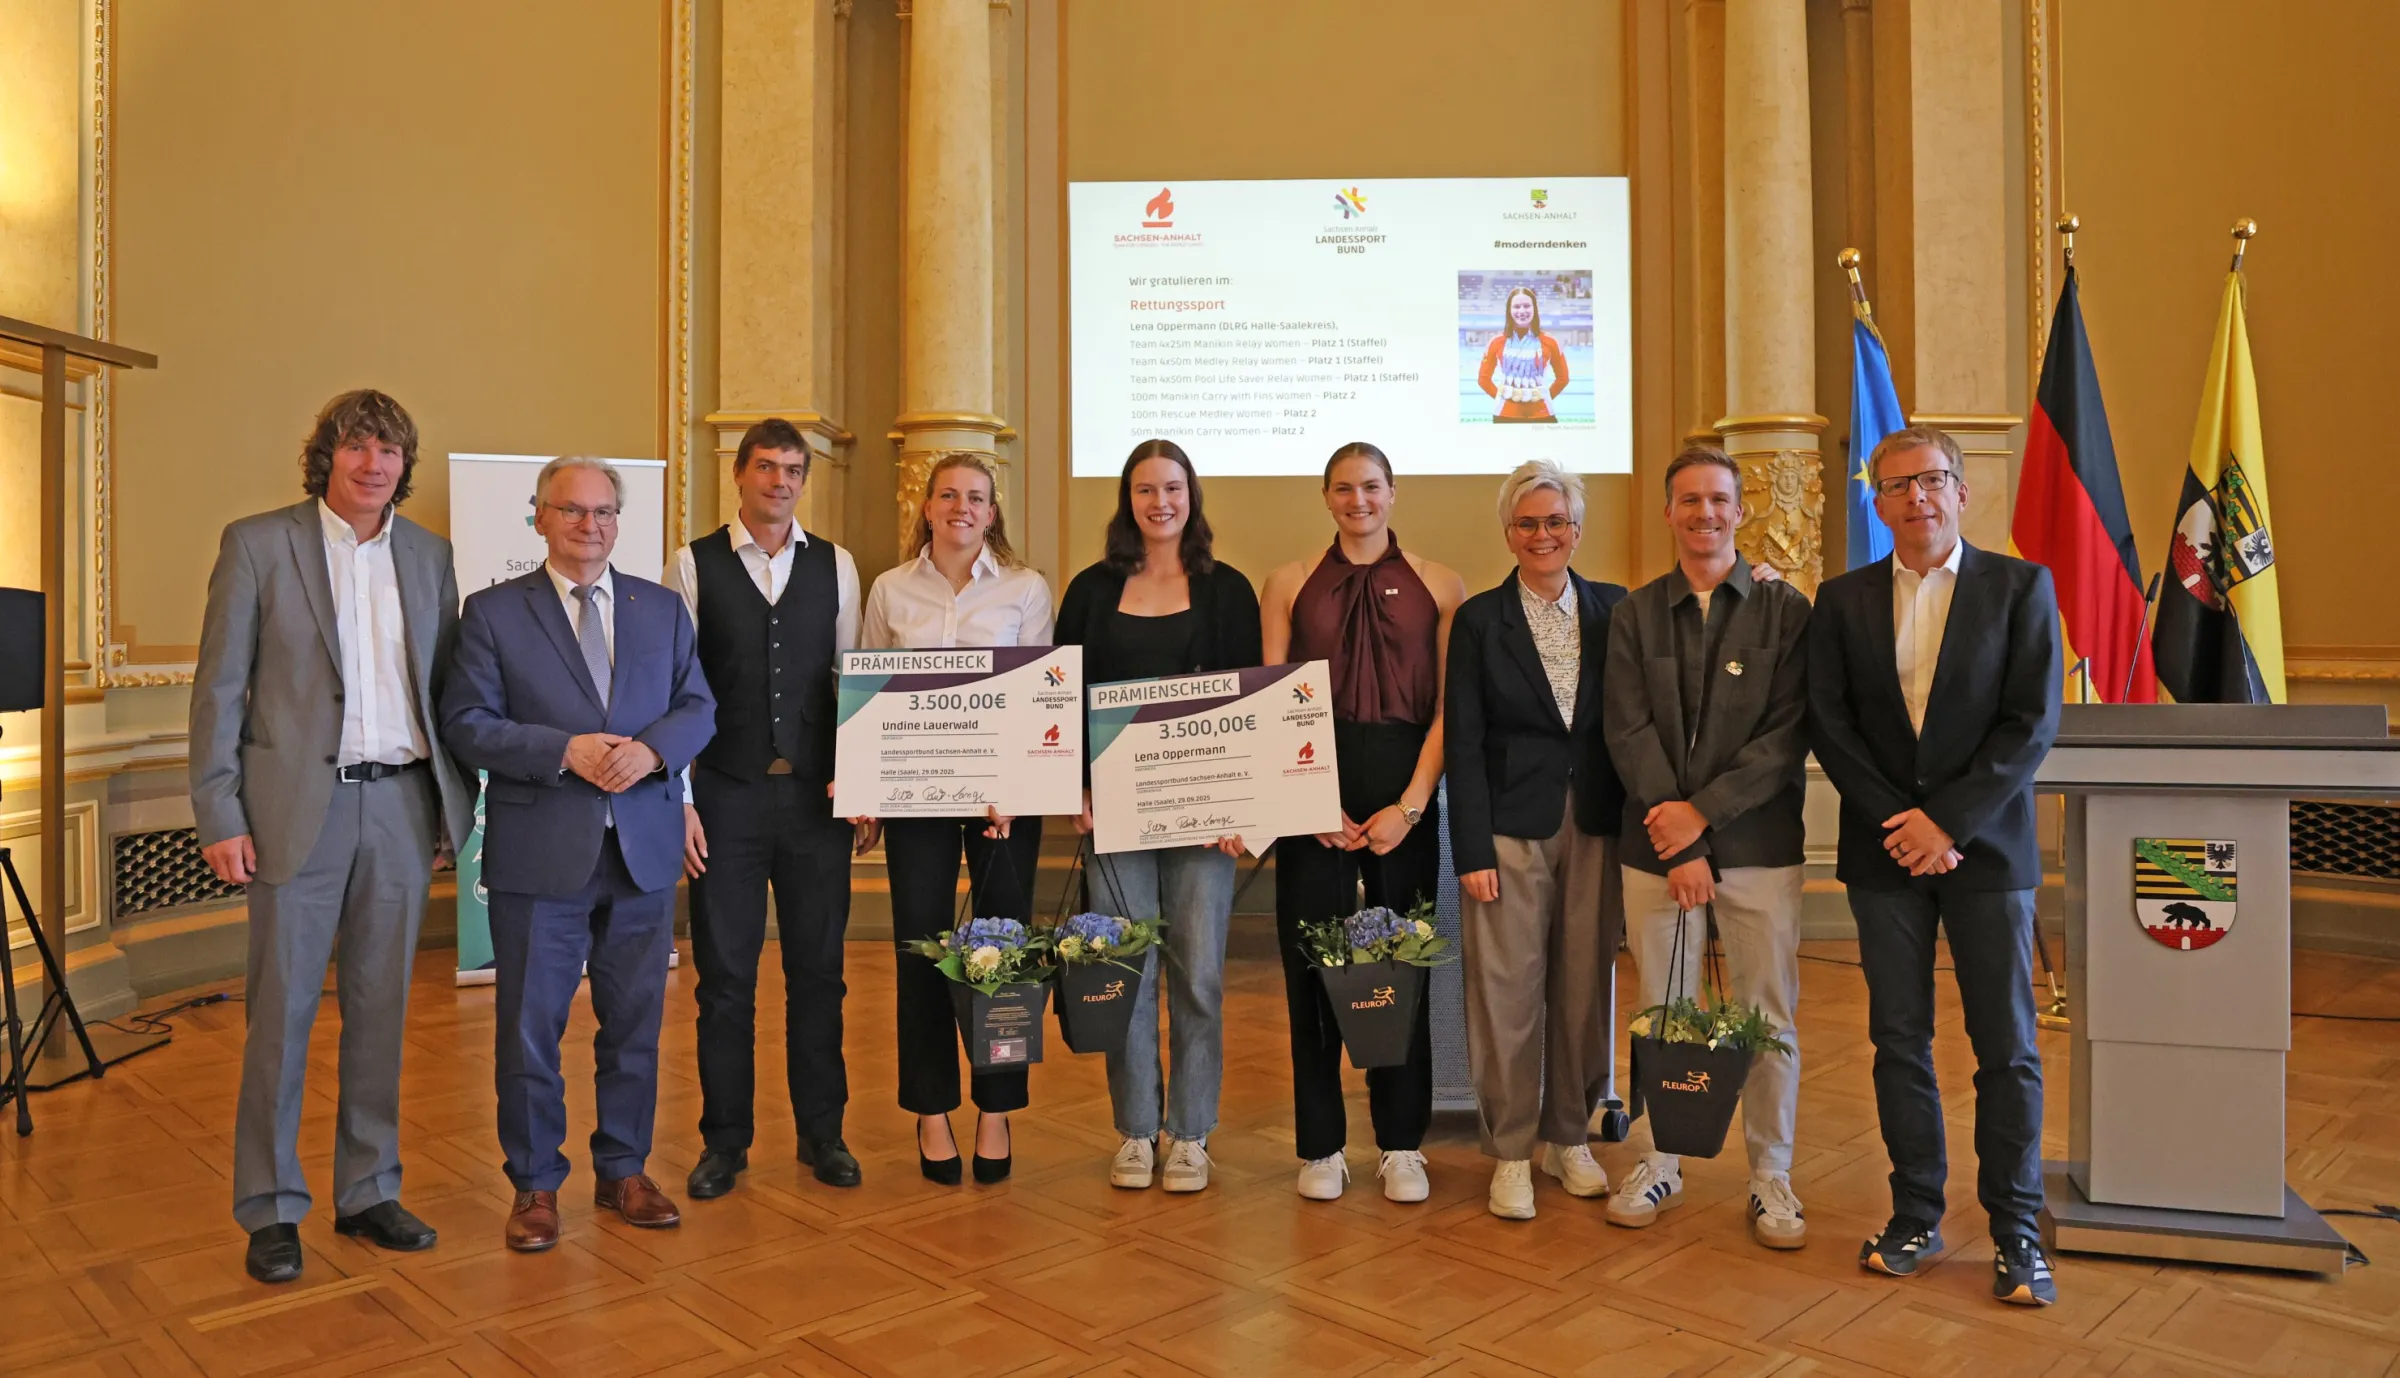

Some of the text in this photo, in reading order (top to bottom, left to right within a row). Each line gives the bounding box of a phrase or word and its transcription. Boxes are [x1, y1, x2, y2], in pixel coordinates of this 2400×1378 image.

[1316, 235, 1386, 244] LANDESSPORT
[1494, 240, 1587, 248] #moderndenken
[1337, 246, 1365, 254] BUND
[1129, 276, 1233, 288] Wir gratulieren im:
[1130, 300, 1225, 312] Rettungssport
[1130, 320, 1338, 332] Lena Oppermann (DLRG Halle-Saalekreis),
[1130, 340, 1157, 348] Team
[1160, 340, 1191, 348] 4x25m
[1236, 340, 1262, 350] Relay
[1312, 339, 1336, 348] Platz
[1339, 339, 1344, 348] 1
[1347, 338, 1387, 348] (Staffel)
[1130, 358, 1157, 366] Team
[1160, 358, 1191, 366] 4x50m
[1194, 357, 1228, 367] Medley
[1232, 356, 1258, 366] Relay
[1308, 356, 1332, 364] Platz
[1336, 356, 1340, 364] 1
[1344, 356, 1384, 365] (Staffel)
[1130, 374, 1157, 383] Team
[1160, 374, 1192, 383] 4x50m
[1195, 374, 1216, 383] Pool
[1219, 374, 1236, 383] Life
[1268, 374, 1294, 384] Relay
[1344, 374, 1368, 382] Platz
[1372, 374, 1376, 382] 1
[1380, 372, 1419, 382] (Staffel)
[1131, 392, 1157, 400] 100m
[1161, 392, 1199, 400] Manikin
[1202, 392, 1228, 402] Carry
[1230, 392, 1250, 400] with
[1323, 392, 1348, 400] Platz
[1350, 392, 1356, 400] 2
[1132, 410, 1158, 418] 100m
[1161, 410, 1196, 418] Rescue
[1200, 410, 1234, 420] Medley
[1284, 409, 1308, 418] Platz
[1311, 409, 1316, 418] 2
[1131, 428, 1152, 436] 50m
[1155, 428, 1194, 436] Manikin
[1196, 428, 1222, 437] Carry
[1272, 426, 1296, 435] Platz
[1300, 426, 1305, 435] 2
[850, 654, 987, 670] PRÄMIENSCHECK
[1098, 678, 1233, 704] PRÄMIENSCHECK
[908, 693, 1006, 712] 3.500,00€
[1282, 712, 1328, 722] LANDESSPORT
[882, 720, 978, 730] Undine Lauerwald
[1159, 714, 1257, 740] 3.500,00€
[880, 749, 934, 757] Landessportbund
[1134, 746, 1226, 762] Lena Oppermann
[1136, 776, 1188, 787] Landessportbund
[1190, 771, 1236, 782] Sachsen-Anhalt
[1178, 794, 1210, 804] 29.09.2025
[1083, 992, 1117, 1002] FLEUROP
[1351, 1000, 1388, 1010] FLEUROP
[1662, 1080, 1700, 1092] FLEUROP
